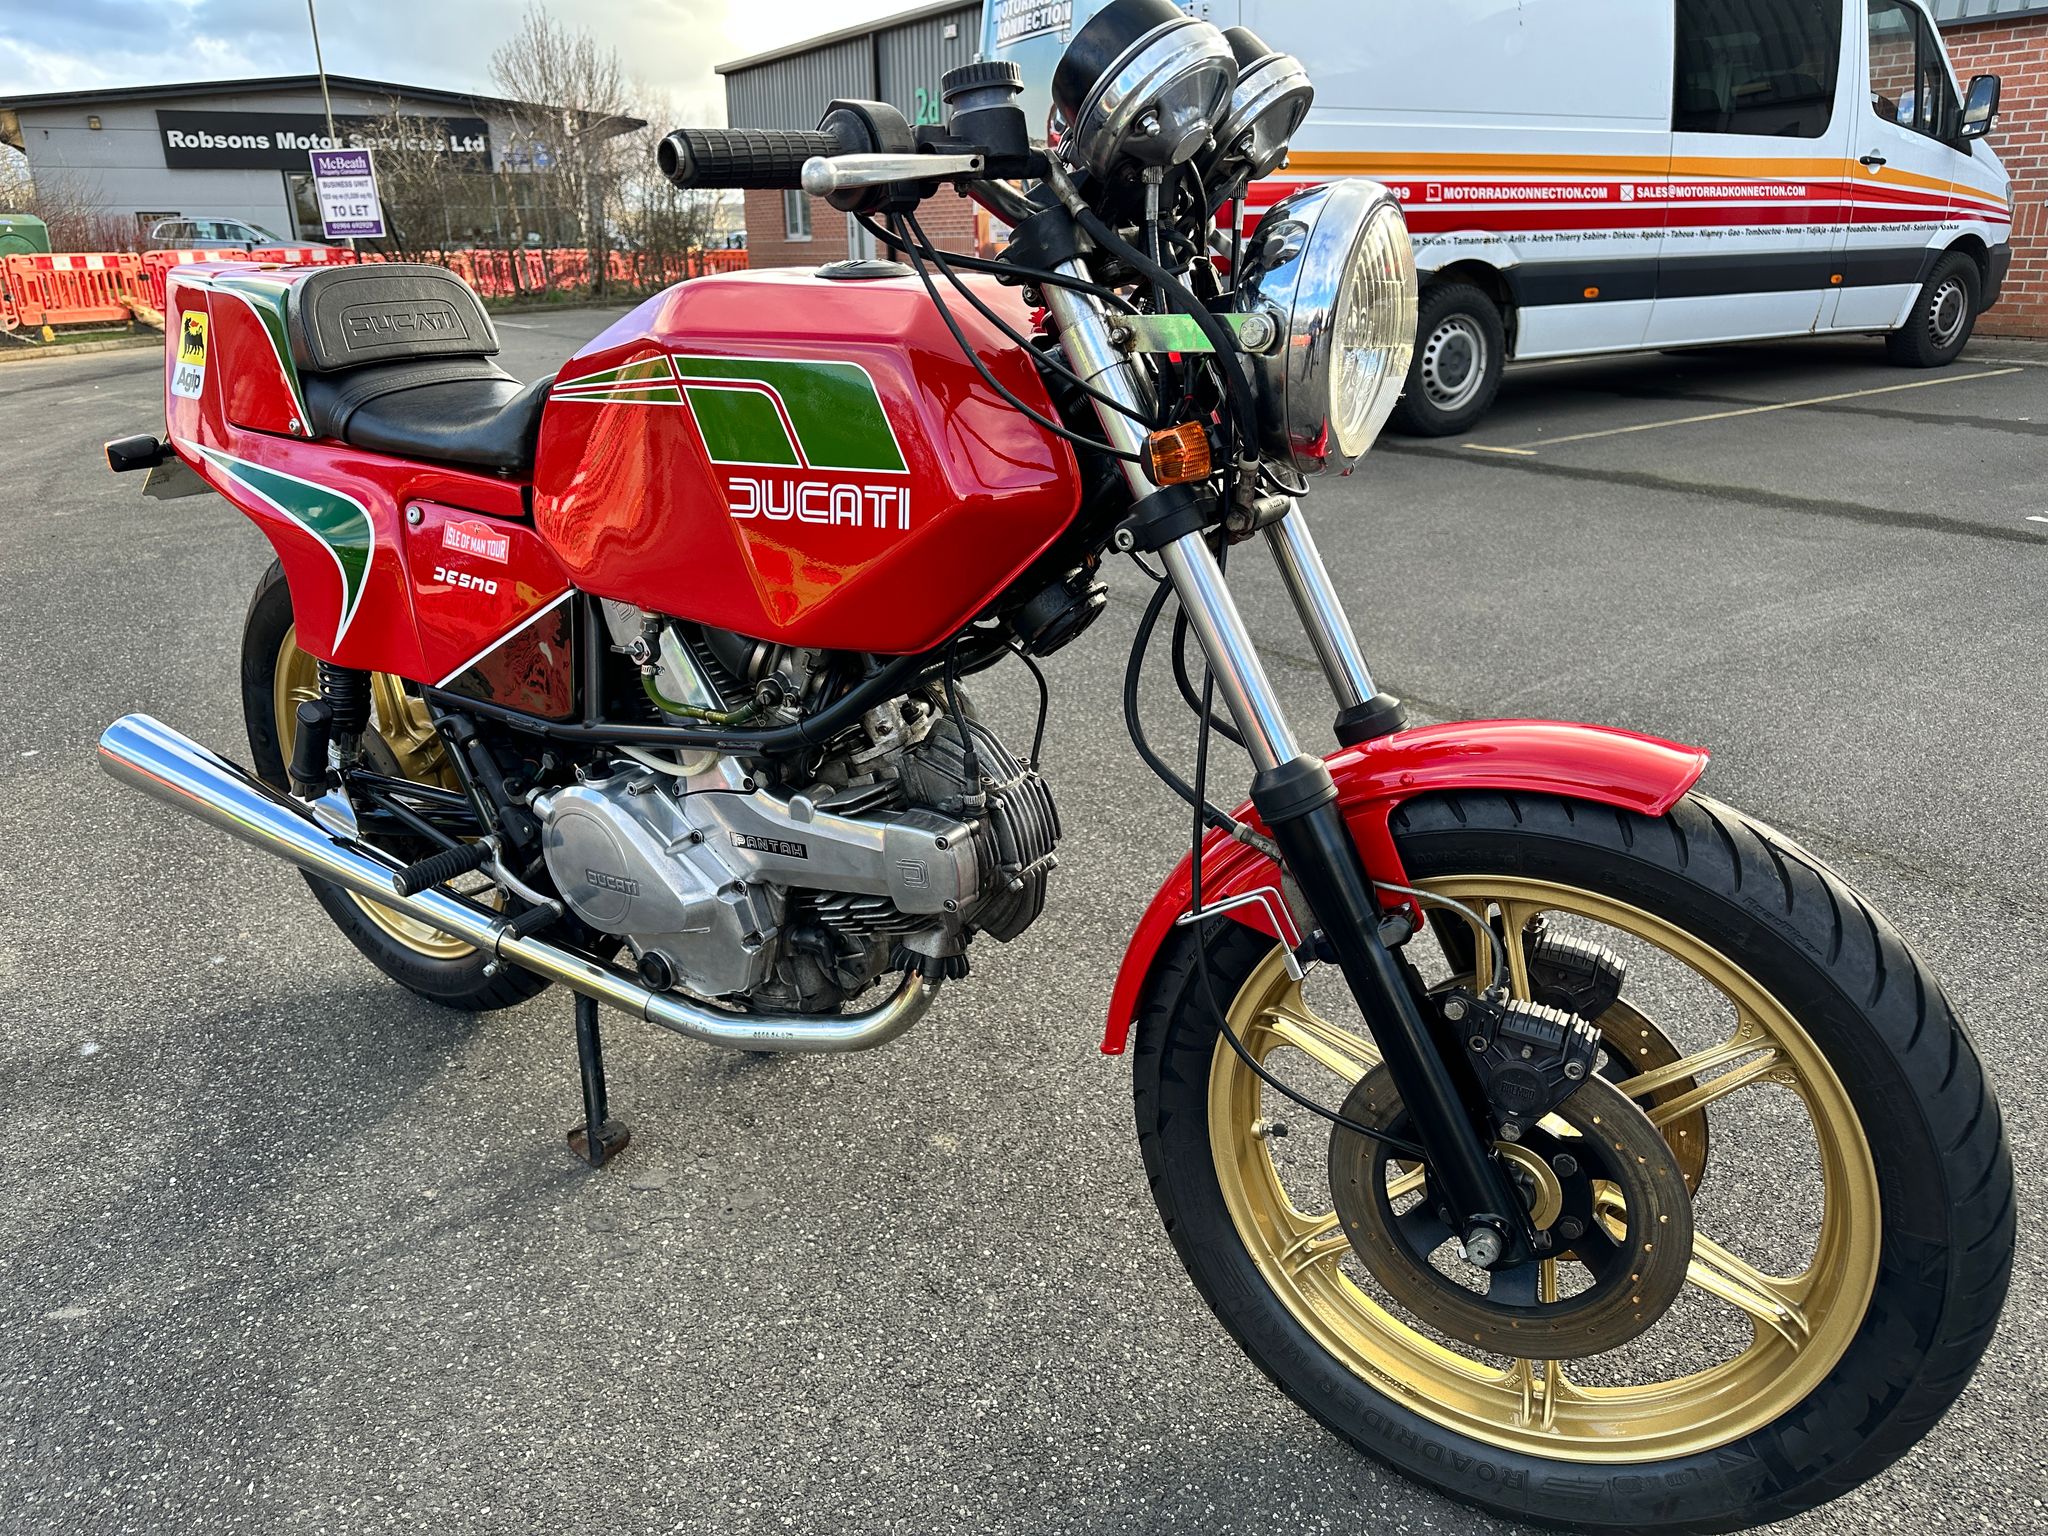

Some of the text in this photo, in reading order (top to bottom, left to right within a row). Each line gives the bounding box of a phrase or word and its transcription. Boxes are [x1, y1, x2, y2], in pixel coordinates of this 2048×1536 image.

[997, 2, 1072, 40] KONNECTION
[915, 88, 940, 124] 2d
[167, 130, 270, 149] Robsons
[276, 132, 342, 149] Motor
[450, 135, 485, 152] Ltd
[319, 156, 367, 170] McBeath
[322, 180, 368, 189] BUSINESS UNIT
[1444, 187, 1608, 200] MOTORRADKONNECTION.COM
[1636, 185, 1806, 198] SALES@MOTORRADKONNECTION.COM
[332, 205, 369, 217] TO LET
[1532, 234, 1553, 243] Arbre
[1555, 233, 1581, 244] Thierry
[1583, 231, 1607, 241] Sabine
[1612, 231, 1636, 239] Dirkou
[1640, 231, 1665, 240] Agadez
[1671, 230, 1695, 238] Tahoua
[1700, 229, 1723, 240] Niamey
[1728, 228, 1741, 237] Gao
[1745, 227, 1782, 236] Tombouctou
[1880, 224, 1900, 232] Richard
[1913, 223, 1926, 231] Saint
[349, 311, 455, 336] DUCATI
[177, 366, 201, 393] Agip
[729, 477, 910, 530] DUCATI
[445, 526, 506, 559] ISLE OF MAN TOUR
[433, 566, 498, 595] DESMO
[733, 834, 804, 857] PANTAH
[588, 871, 638, 894] DUCATI
[1316, 1376, 1523, 1490] ROADRIDER
